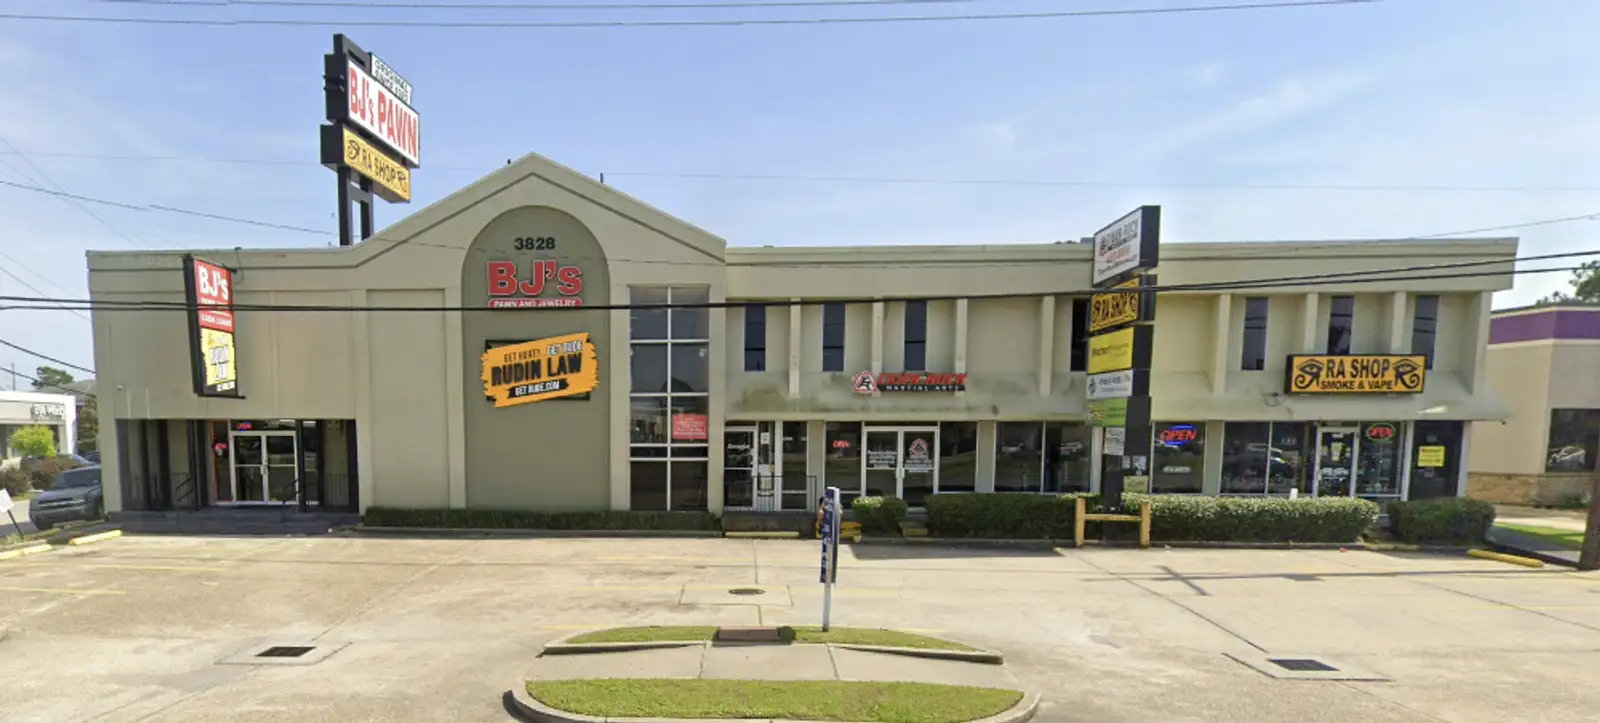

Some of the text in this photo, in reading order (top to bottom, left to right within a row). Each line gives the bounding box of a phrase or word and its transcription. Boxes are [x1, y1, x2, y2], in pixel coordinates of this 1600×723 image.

[350, 67, 418, 158] BJ's PAWN
[361, 149, 397, 185] RA SHOP
[514, 237, 556, 250] 3828
[198, 265, 229, 300] BJ's
[487, 260, 583, 296] BJ's
[494, 299, 577, 308] PAWN AND JEWELRY
[547, 344, 561, 355] GET
[504, 352, 517, 362] GET
[491, 353, 582, 386] RUDIN LAW
[1326, 358, 1391, 379] RA SHOP
[515, 386, 527, 396] GET
[1320, 380, 1393, 390] SMOKE & VAPE
[1160, 430, 1197, 441] OPEN
[1368, 427, 1393, 438] OPEN
